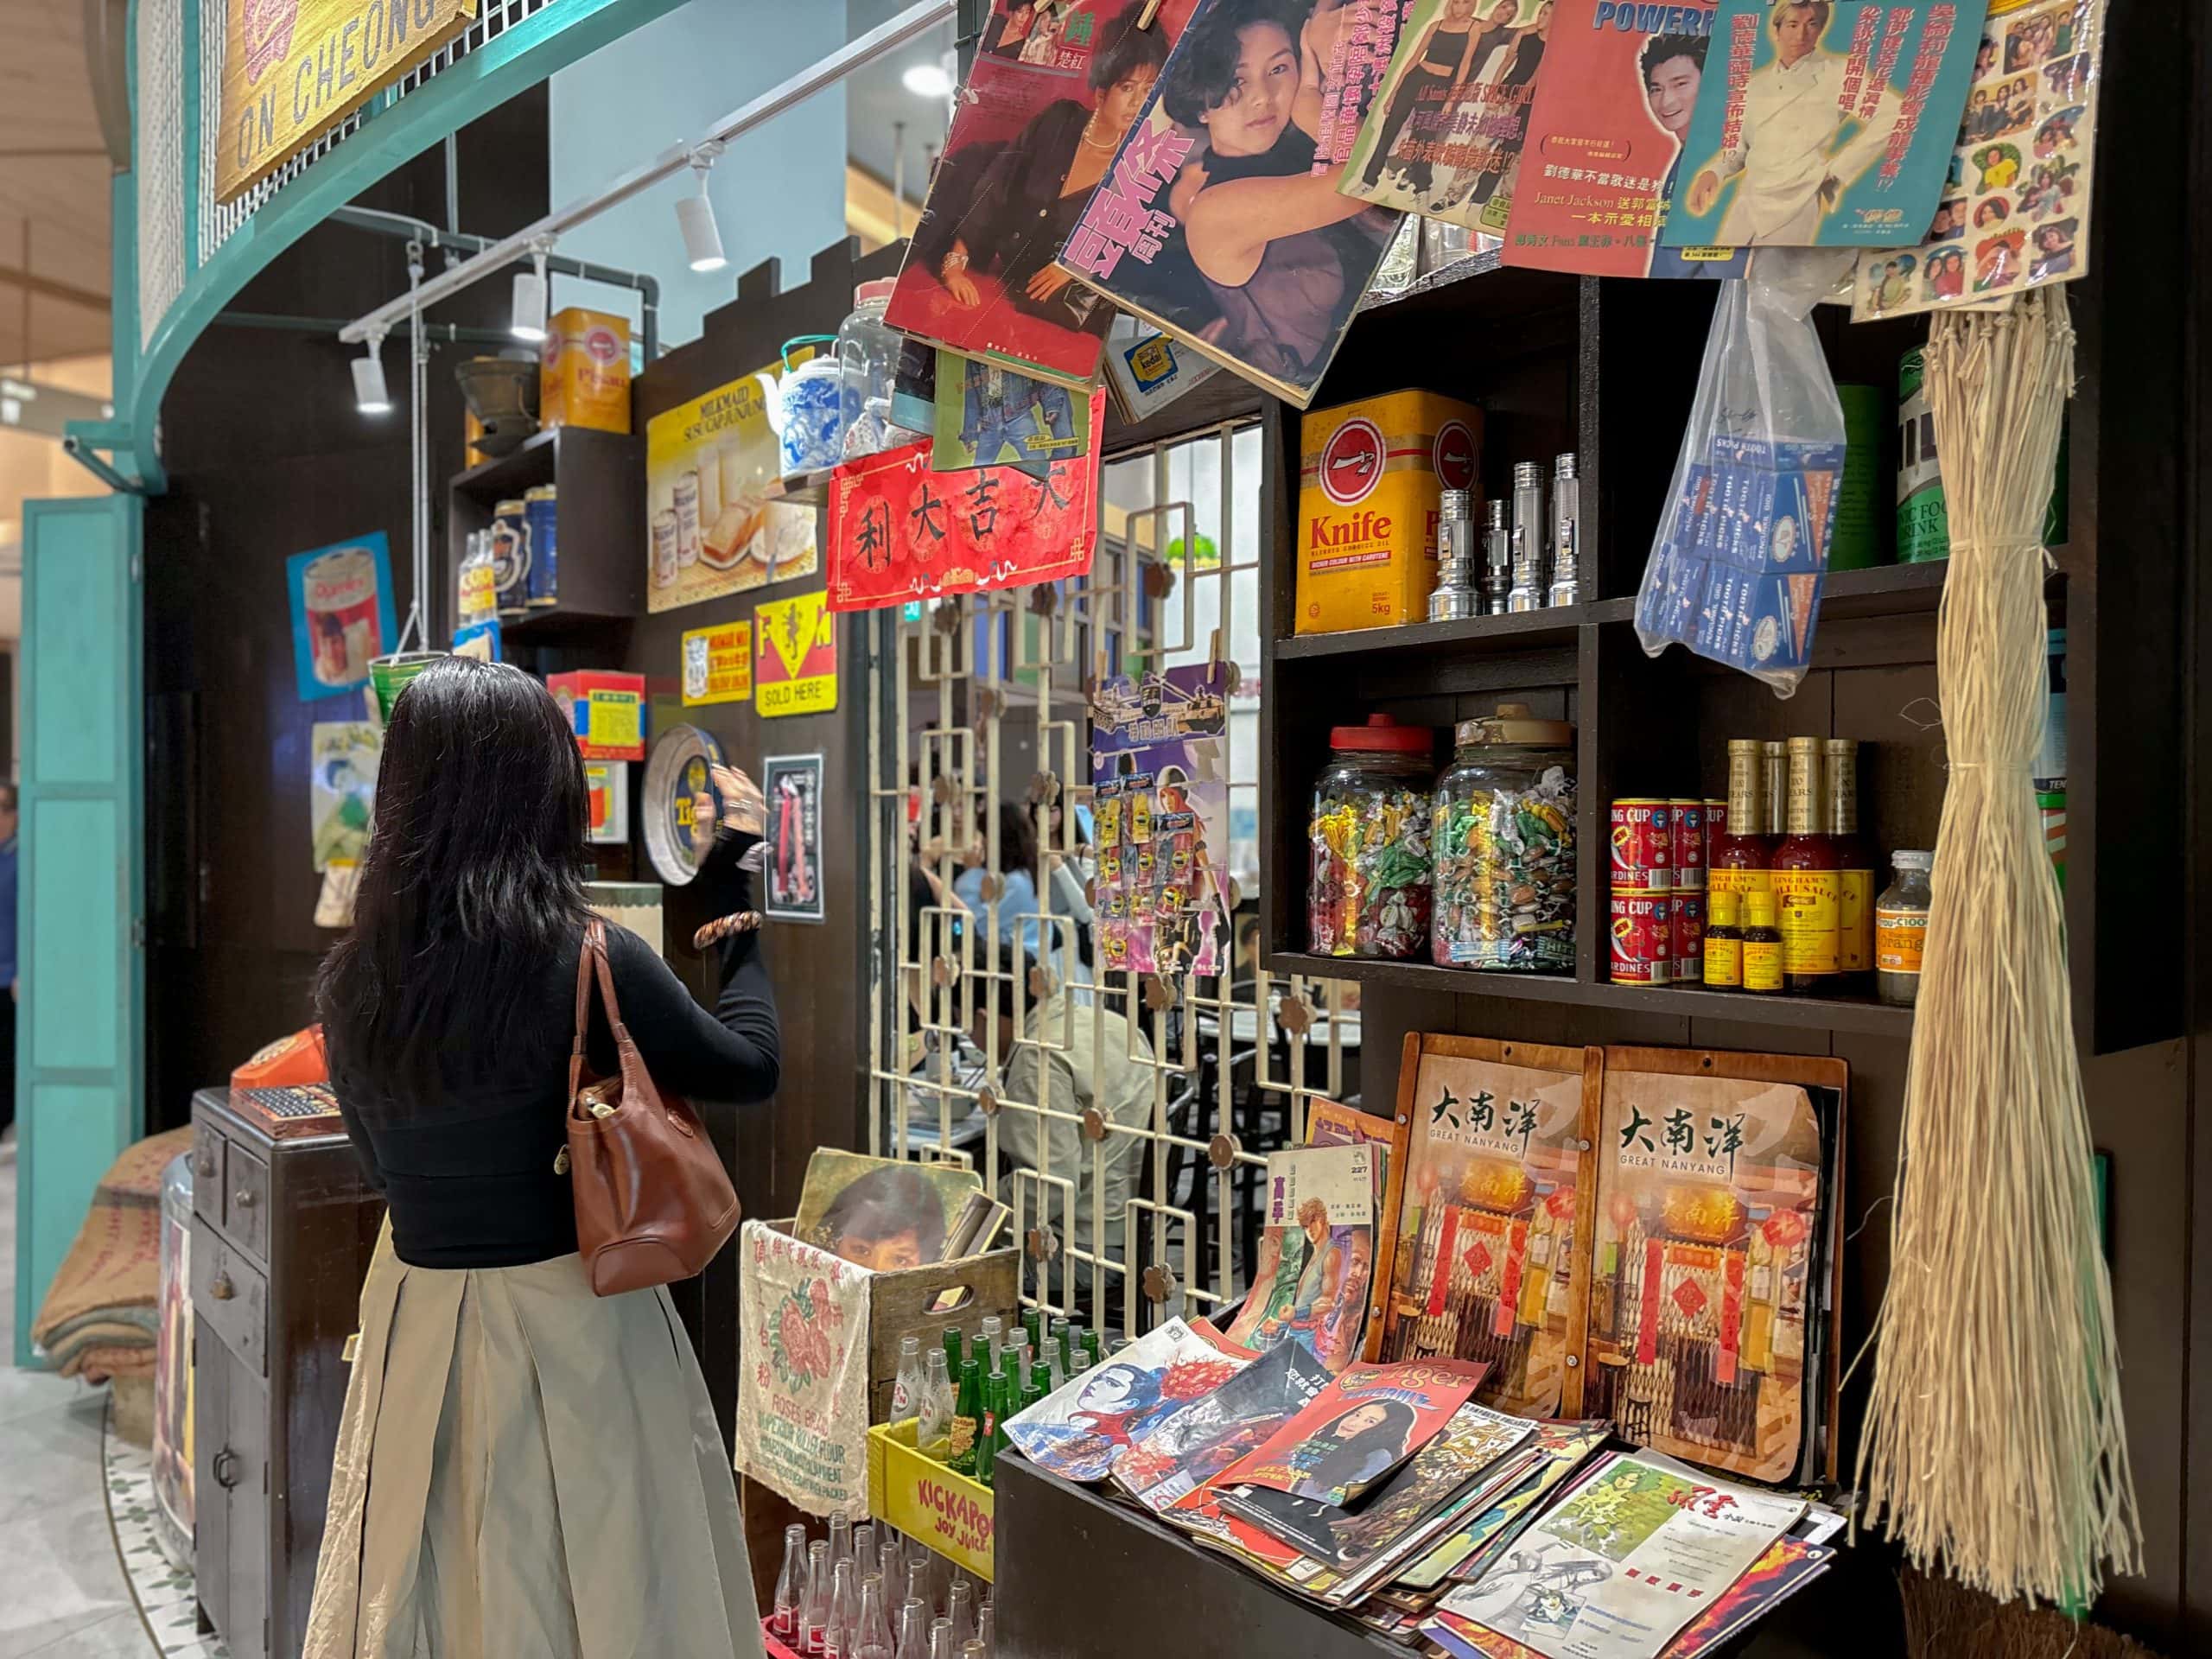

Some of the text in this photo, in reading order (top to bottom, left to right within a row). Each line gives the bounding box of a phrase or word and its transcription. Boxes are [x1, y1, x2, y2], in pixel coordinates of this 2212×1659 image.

[238, 83, 276, 168] ON
[1064, 118, 1195, 279] 頭條
[1535, 192, 1565, 206] Janet
[1567, 194, 1613, 208] Jackson
[1132, 210, 1176, 264] 周刊
[1310, 511, 1392, 550] Knife
[765, 681, 822, 707] SOLD HERE
[1626, 809, 1651, 822] CUP
[1628, 901, 1653, 914] CUP
[1432, 1085, 1541, 1160] 大南洋
[1430, 1129, 1519, 1153] GREAT NANYANG
[1620, 1104, 1745, 1182] 大南洋
[1620, 1154, 1726, 1175] GREAT NANYANG
[1386, 1363, 1473, 1389] Tiger
[918, 1478, 994, 1539] KICKAPO
[934, 1516, 957, 1539] JOY
